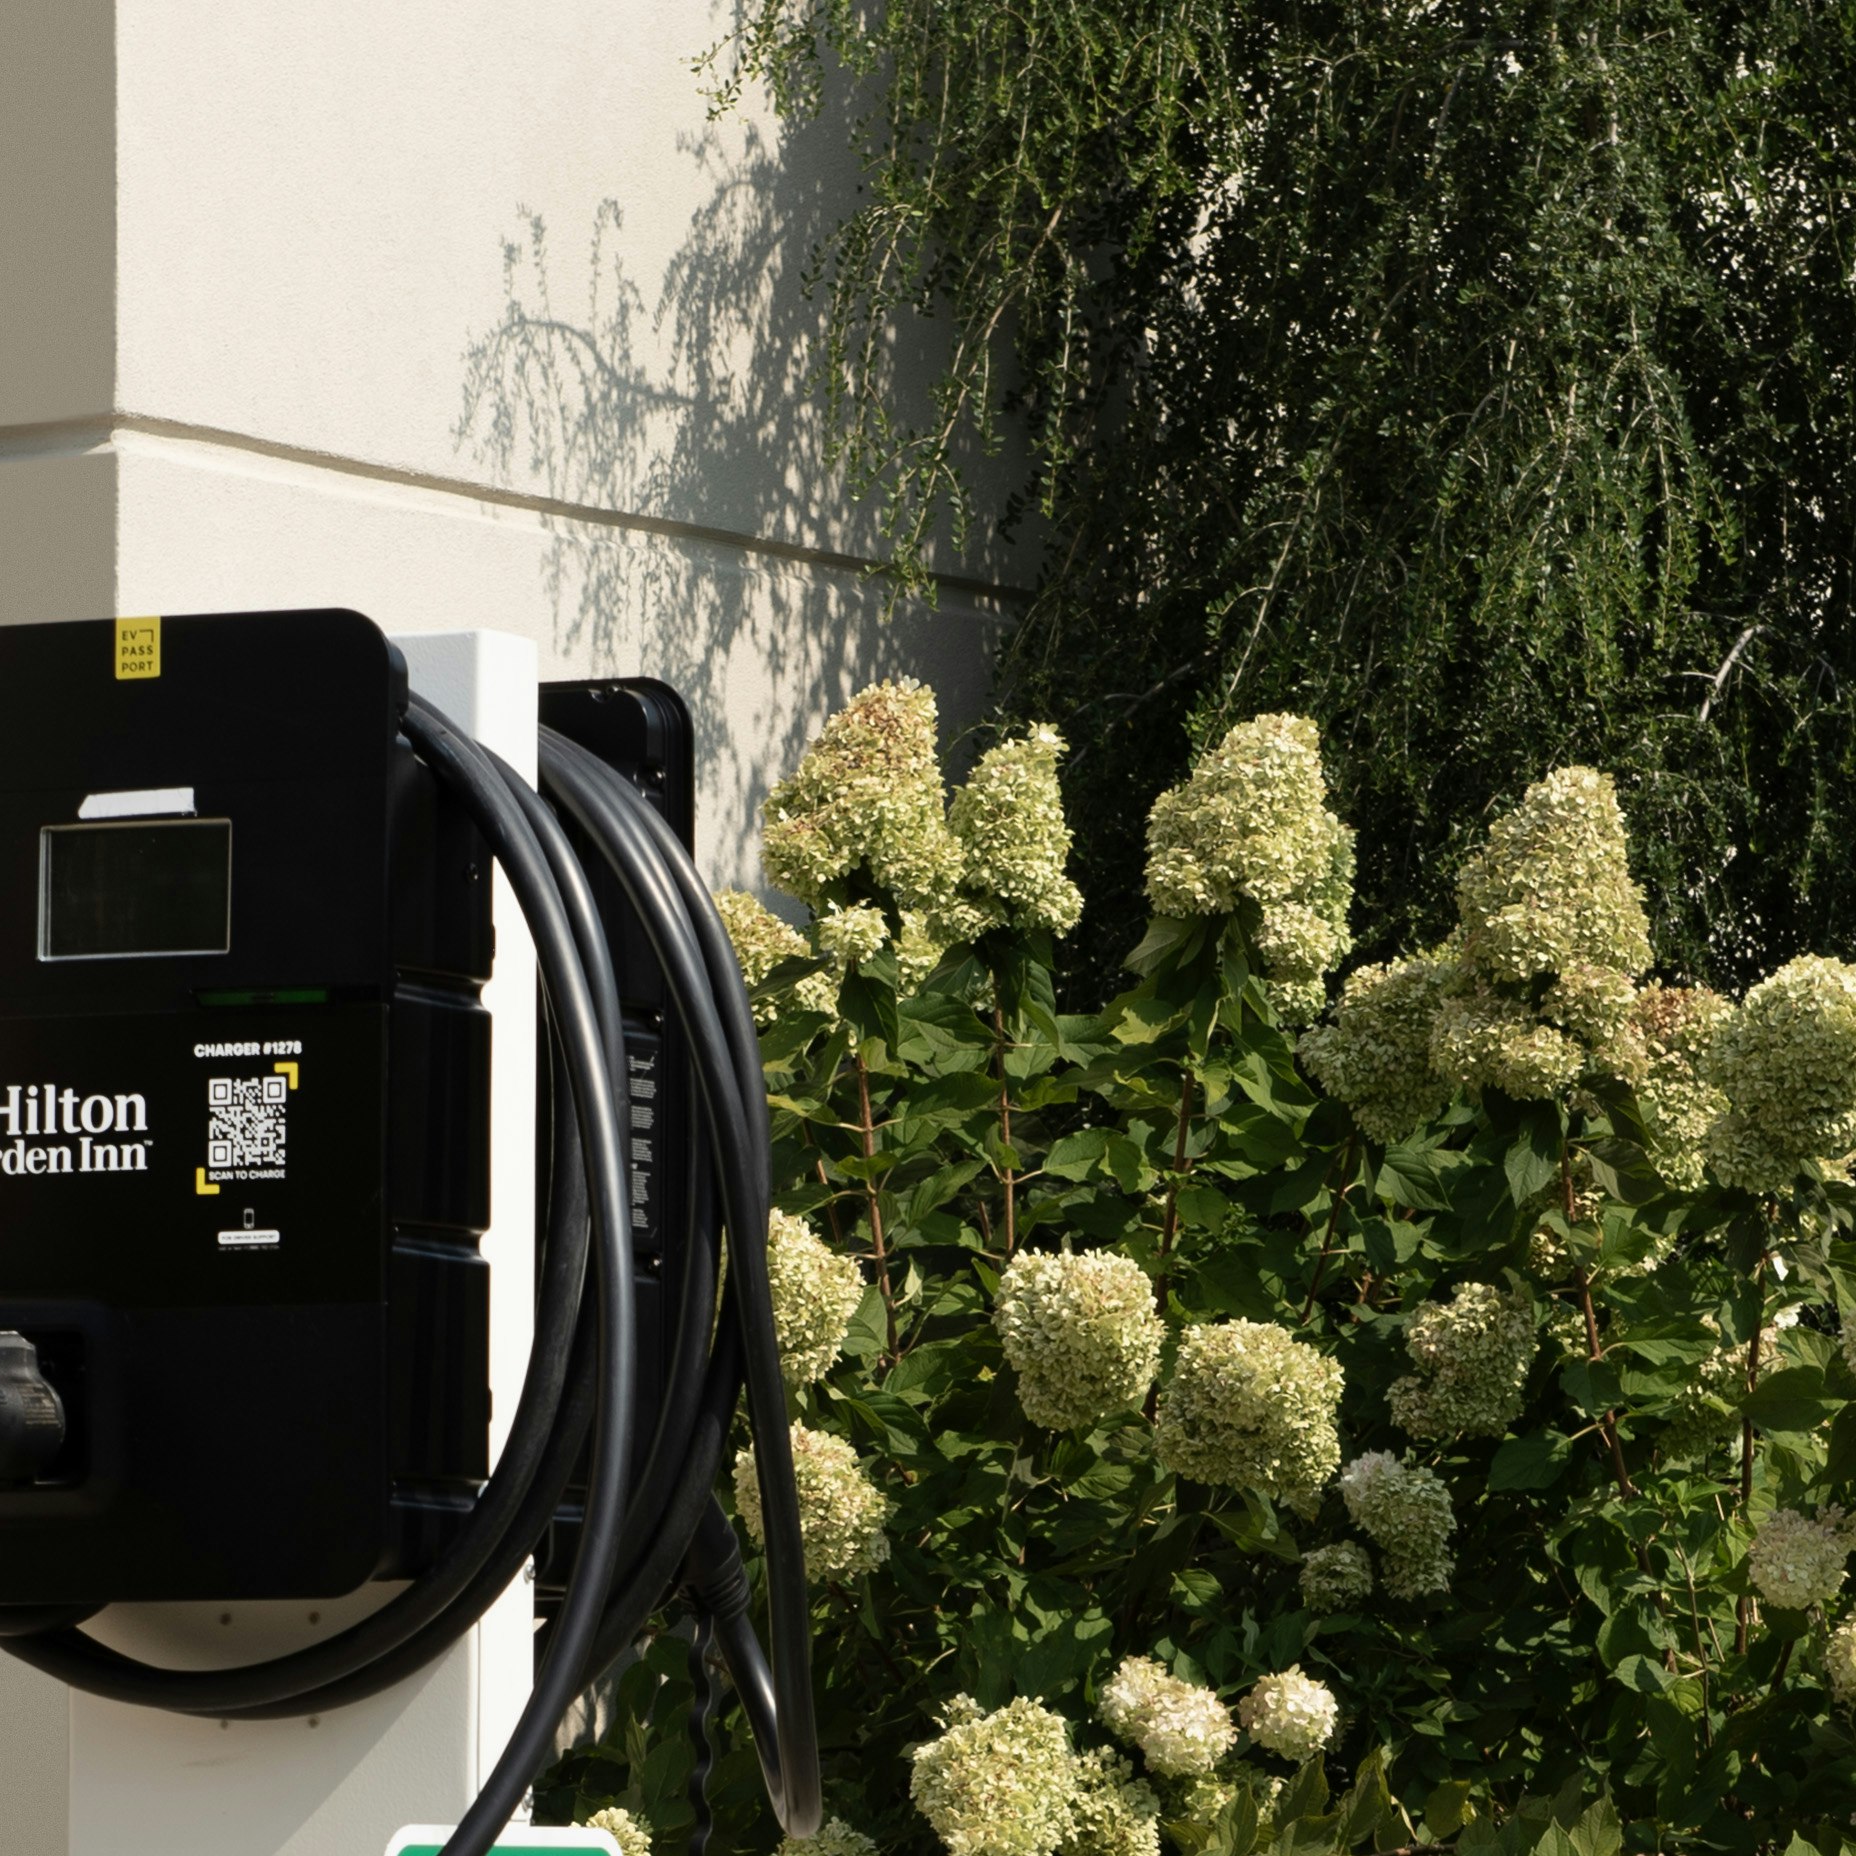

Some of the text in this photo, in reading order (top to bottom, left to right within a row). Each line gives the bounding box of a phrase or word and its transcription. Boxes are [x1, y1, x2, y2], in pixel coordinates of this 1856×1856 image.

[121, 630, 137, 641] EV
[121, 645, 153, 657] PASS
[121, 661, 153, 672] PORT
[194, 1040, 302, 1058] CHARGER #1278
[208, 1168, 285, 1181] SCAN TO CHARGE
